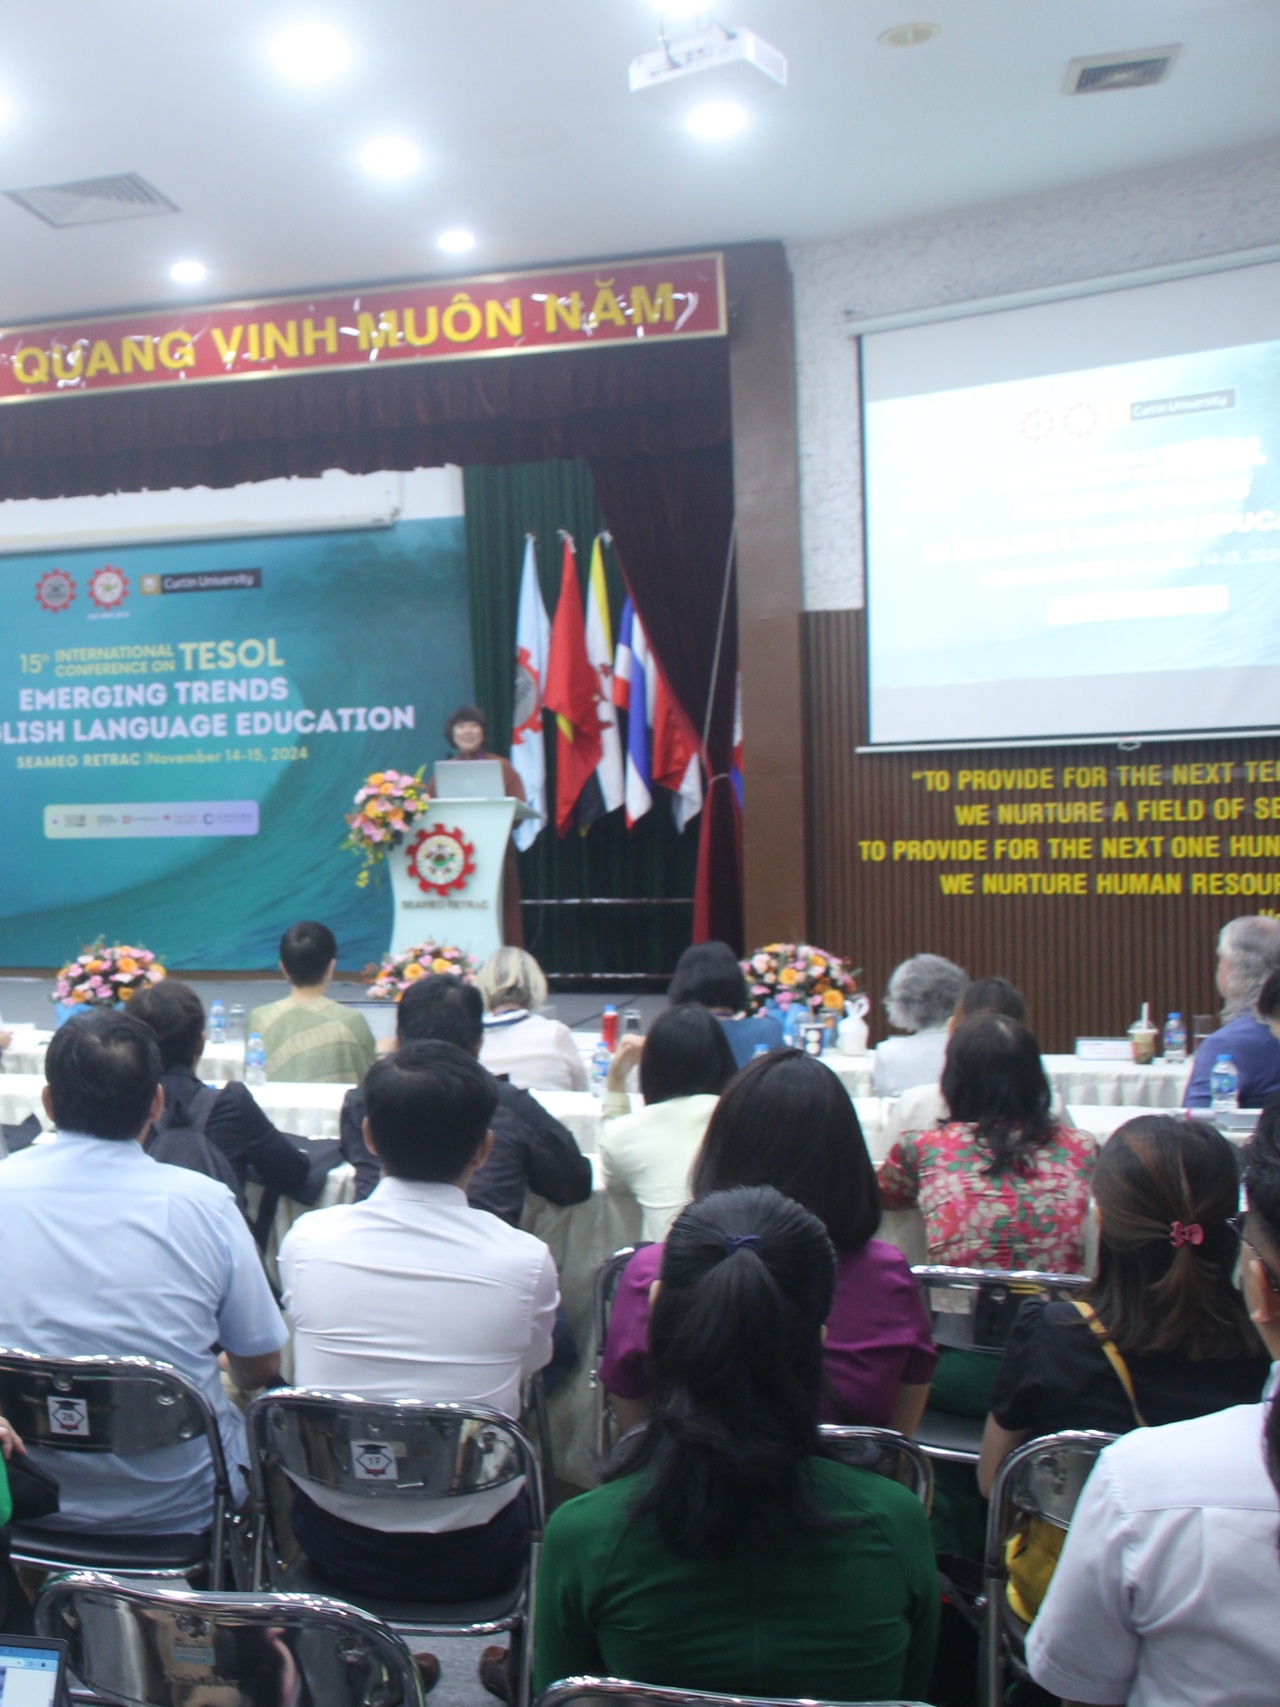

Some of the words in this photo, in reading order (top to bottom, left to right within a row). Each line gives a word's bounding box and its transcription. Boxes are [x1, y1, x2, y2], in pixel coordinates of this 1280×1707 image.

[13, 331, 195, 386] QUANG
[212, 317, 337, 364] VINH
[357, 294, 522, 351] MUÔN
[544, 278, 676, 333] NĂM
[163, 575, 196, 590] Curtin
[198, 572, 255, 588] University
[55, 643, 175, 662] INTERNATIONAL
[178, 637, 284, 671] TESOL
[55, 661, 148, 677] CONFERENCE
[152, 659, 176, 673] ON
[19, 683, 167, 711] EMERGING
[174, 677, 289, 706] TRENDS
[73, 713, 228, 742] LANGUAGE
[236, 705, 416, 738] EDUCATION
[17, 755, 78, 769] SEAMEO
[83, 752, 141, 767] RETRAC
[271, 746, 308, 761] 2024
[958, 767, 1054, 790] PROVIDE
[1064, 766, 1108, 788] FOR
[1117, 764, 1162, 787] THE
[1172, 762, 1236, 785] NEXT
[955, 805, 990, 826] WE
[998, 802, 1104, 825] NURTURE
[1112, 801, 1129, 822] A
[1137, 799, 1205, 822] FIELD
[1213, 797, 1246, 821] OF
[858, 840, 886, 861] TO
[893, 839, 988, 861] PROVIDE
[994, 838, 1039, 860] FOR
[1047, 837, 1093, 859] THE
[1101, 836, 1165, 859] NEXT
[1171, 835, 1221, 859] ONE
[939, 874, 974, 895] WE
[982, 874, 1088, 896] NURTURE
[1096, 873, 1182, 895] HUMAN
